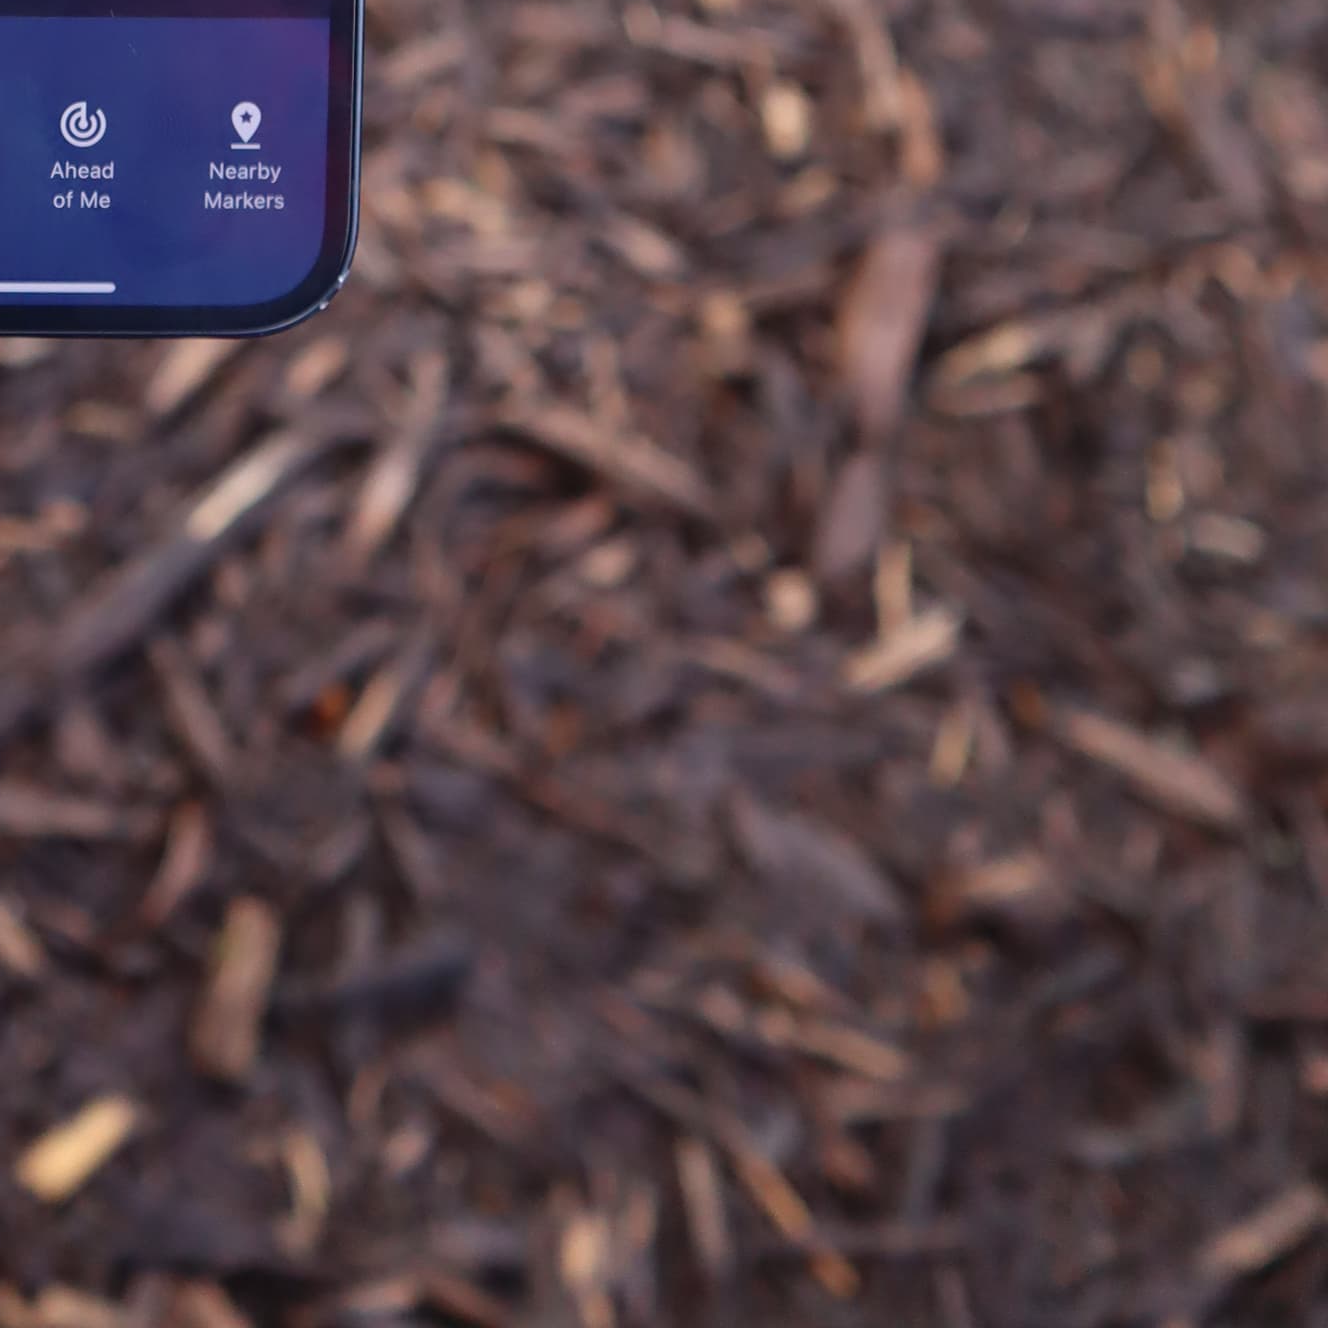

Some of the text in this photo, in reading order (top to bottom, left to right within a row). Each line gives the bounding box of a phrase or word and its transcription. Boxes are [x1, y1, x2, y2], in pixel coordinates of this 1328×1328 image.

[50, 161, 114, 179] Ahead
[209, 162, 281, 183] Nearby
[53, 191, 111, 208] of Me
[204, 192, 285, 210] Markers
